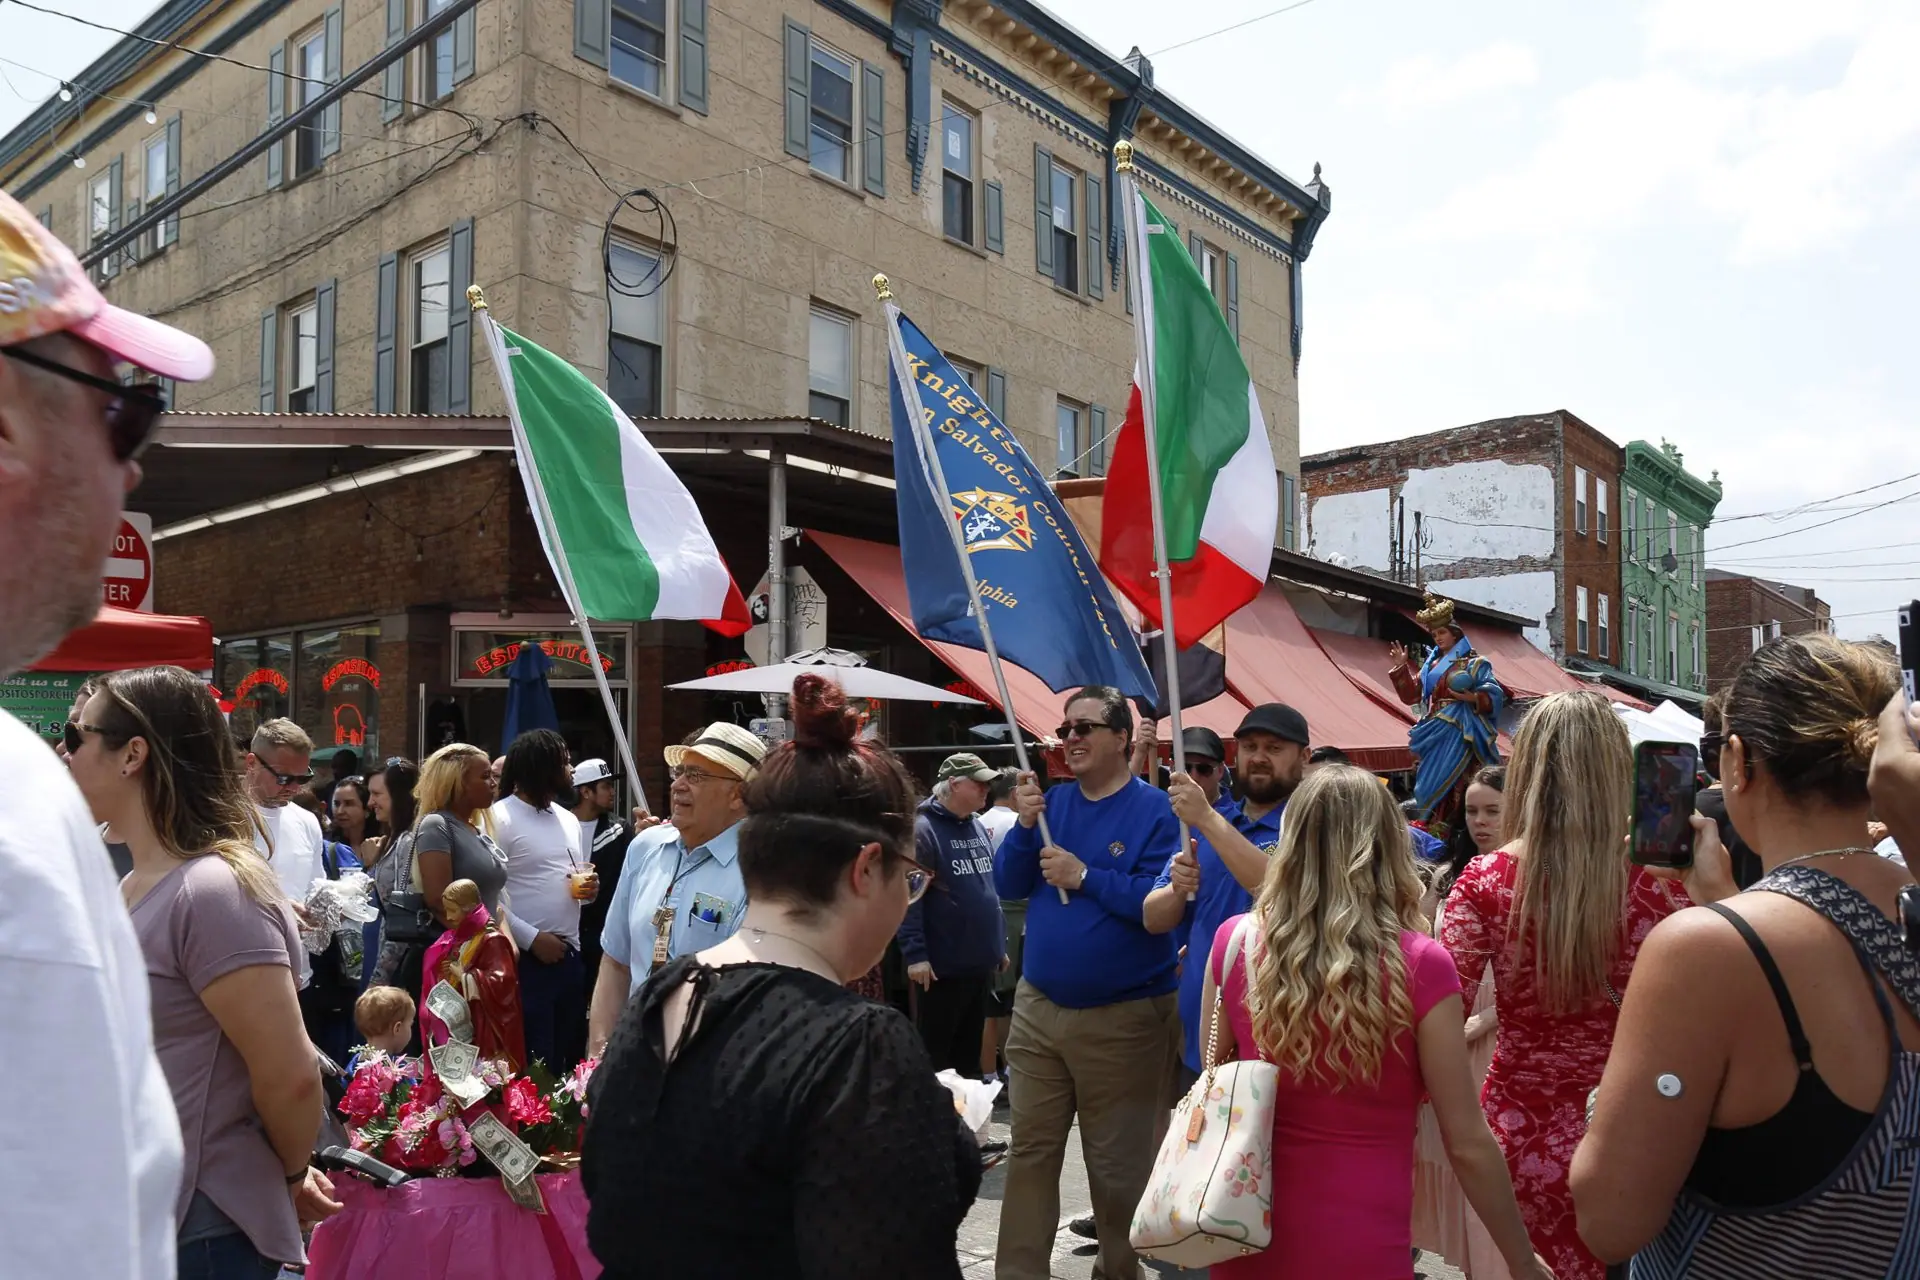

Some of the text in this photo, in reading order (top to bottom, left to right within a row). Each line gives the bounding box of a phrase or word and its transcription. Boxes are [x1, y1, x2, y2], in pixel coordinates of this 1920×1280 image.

[906, 352, 1016, 455] Knights
[938, 417, 1031, 494] Salvador
[994, 506, 1011, 516] OF
[1009, 517, 1023, 527] C
[112, 535, 136, 553] OT
[975, 579, 1019, 609] lphia
[4, 676, 26, 686] isit
[53, 678, 69, 687] at
[952, 859, 974, 875] SAN
